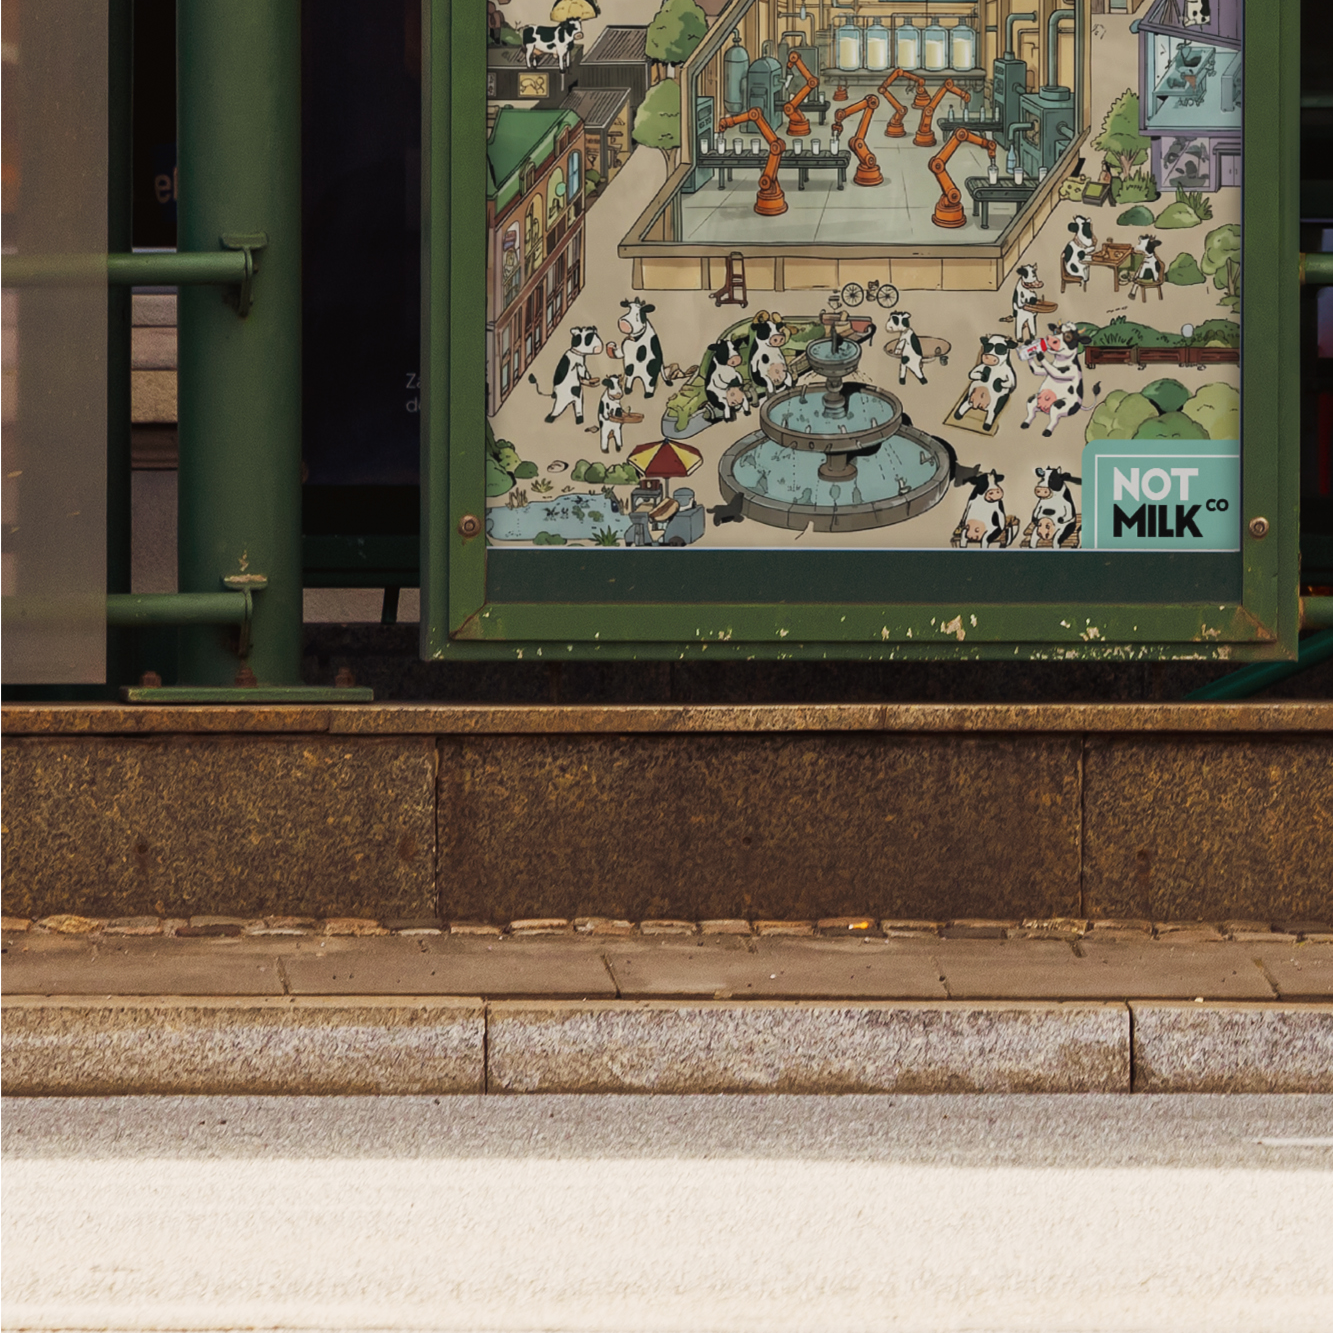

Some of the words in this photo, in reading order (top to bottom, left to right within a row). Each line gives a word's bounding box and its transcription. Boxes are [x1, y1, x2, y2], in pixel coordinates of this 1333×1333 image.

[1113, 467, 1199, 501] NOT
[1113, 503, 1203, 538] MILK
[1206, 498, 1229, 512] CO
